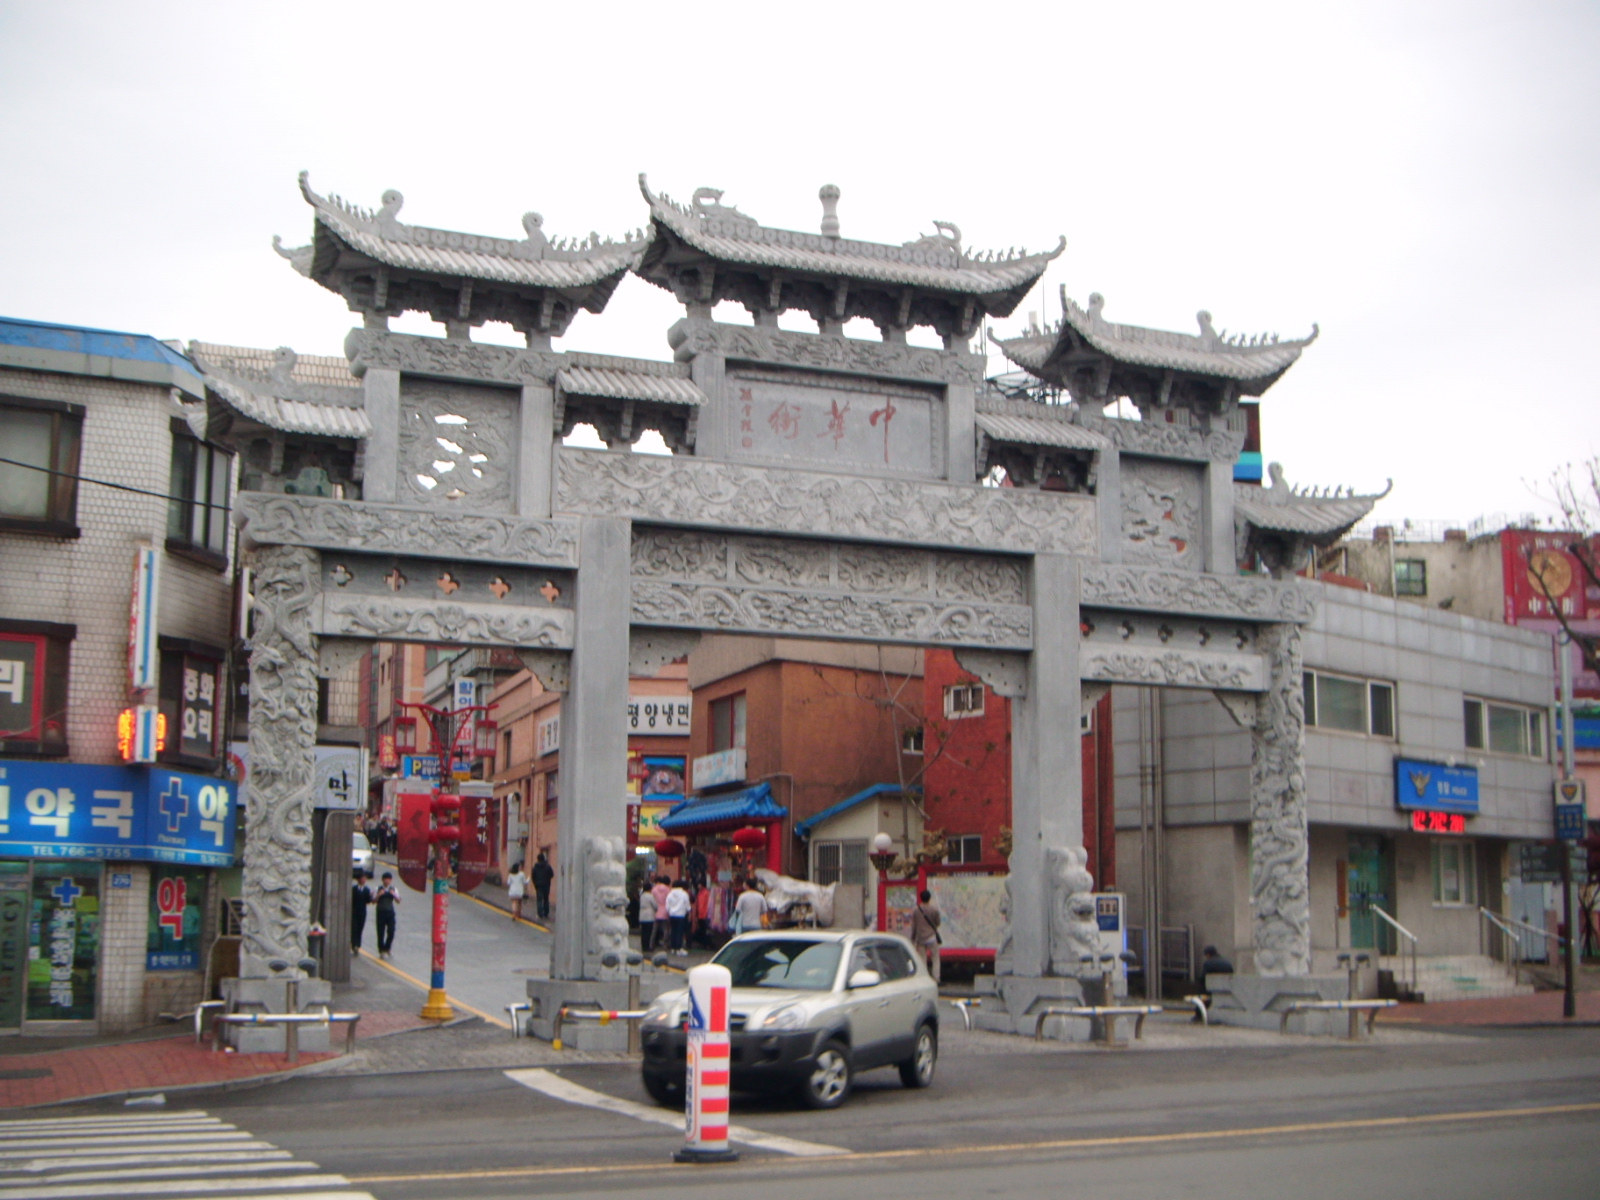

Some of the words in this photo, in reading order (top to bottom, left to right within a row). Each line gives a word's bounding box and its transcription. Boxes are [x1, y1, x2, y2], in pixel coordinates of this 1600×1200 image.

[627, 703, 690, 728] 평양냉면
[328, 769, 352, 801] 막
[0, 785, 134, 838] 약국
[198, 784, 229, 846] 약
[33, 845, 57, 856] TEL
[60, 846, 131, 858] 766-5755
[156, 876, 187, 941] 약
